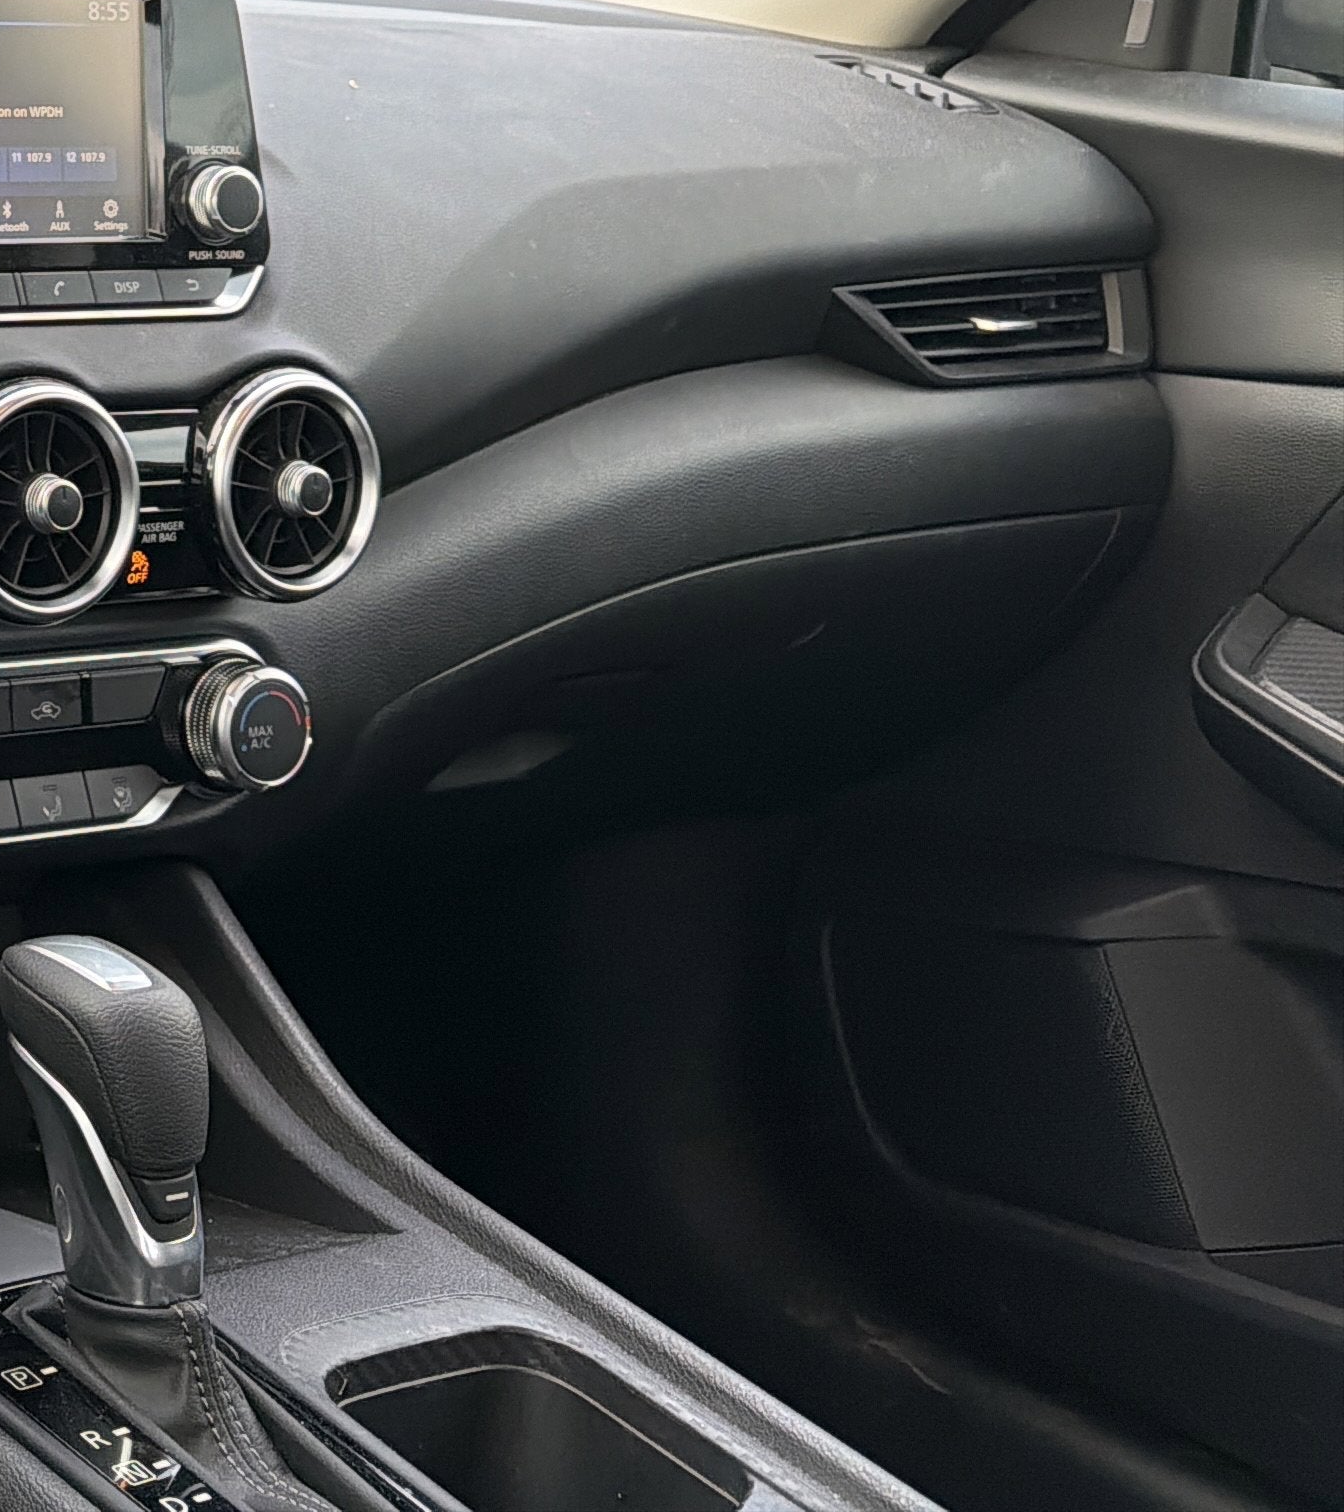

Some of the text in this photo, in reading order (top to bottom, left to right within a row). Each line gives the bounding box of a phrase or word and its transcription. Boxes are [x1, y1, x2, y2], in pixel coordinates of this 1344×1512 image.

[88, 1, 131, 22] 8:55
[13, 108, 27, 118] on
[29, 105, 63, 118] WPDH
[26, 152, 52, 163] 107.9
[80, 152, 106, 163] 107.9
[50, 222, 71, 232] AUX
[94, 221, 128, 233] Settings
[189, 250, 245, 260] PUSH SOUND
[114, 281, 140, 294] DISP
[141, 532, 177, 543] AIR BAG
[127, 572, 149, 584] OFF
[248, 725, 274, 737] MAX
[251, 737, 271, 749] A/C
[11, 1371, 28, 1386] P
[80, 1430, 112, 1449] R
[120, 1463, 148, 1482] N
[159, 1497, 189, 1512] D
